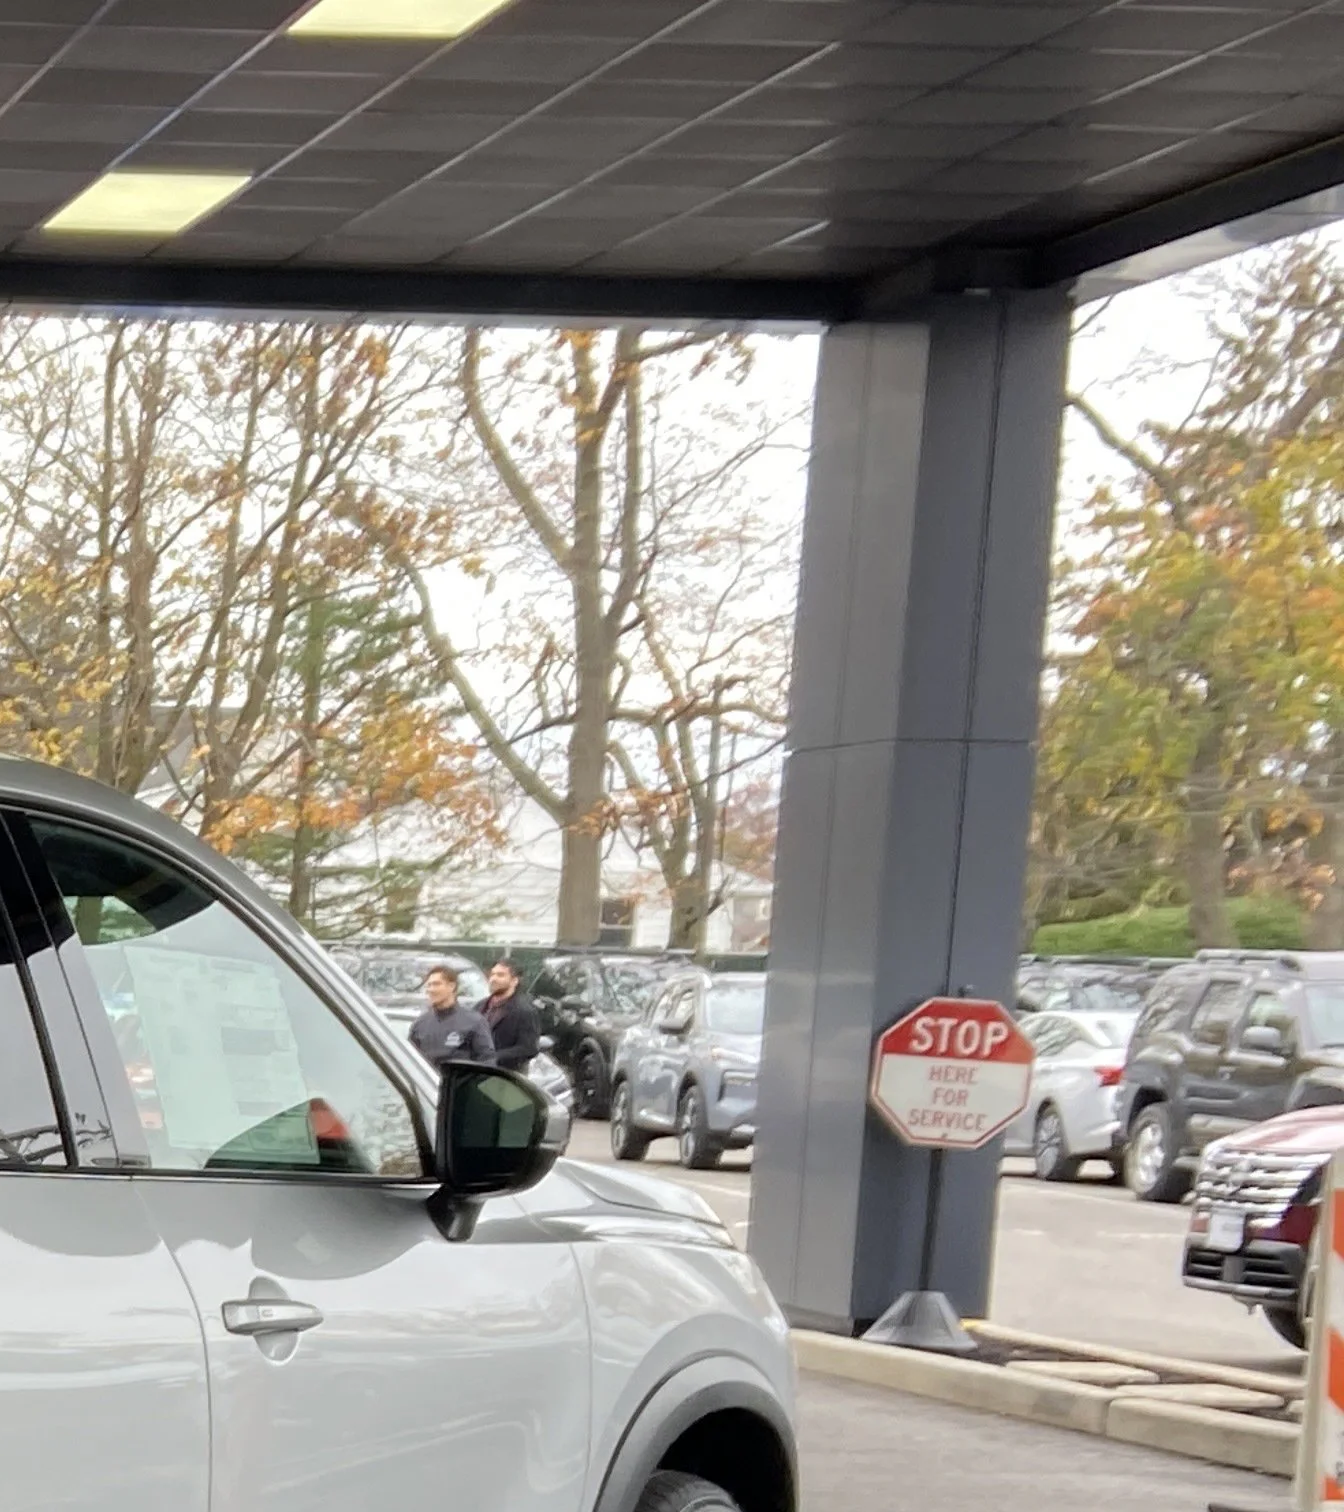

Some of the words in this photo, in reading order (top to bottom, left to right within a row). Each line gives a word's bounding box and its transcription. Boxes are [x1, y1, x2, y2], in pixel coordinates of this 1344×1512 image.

[909, 1016, 1009, 1057] STOP
[928, 1065, 981, 1084] HERE
[932, 1087, 970, 1106] FOR
[908, 1109, 988, 1131] SERVICE
